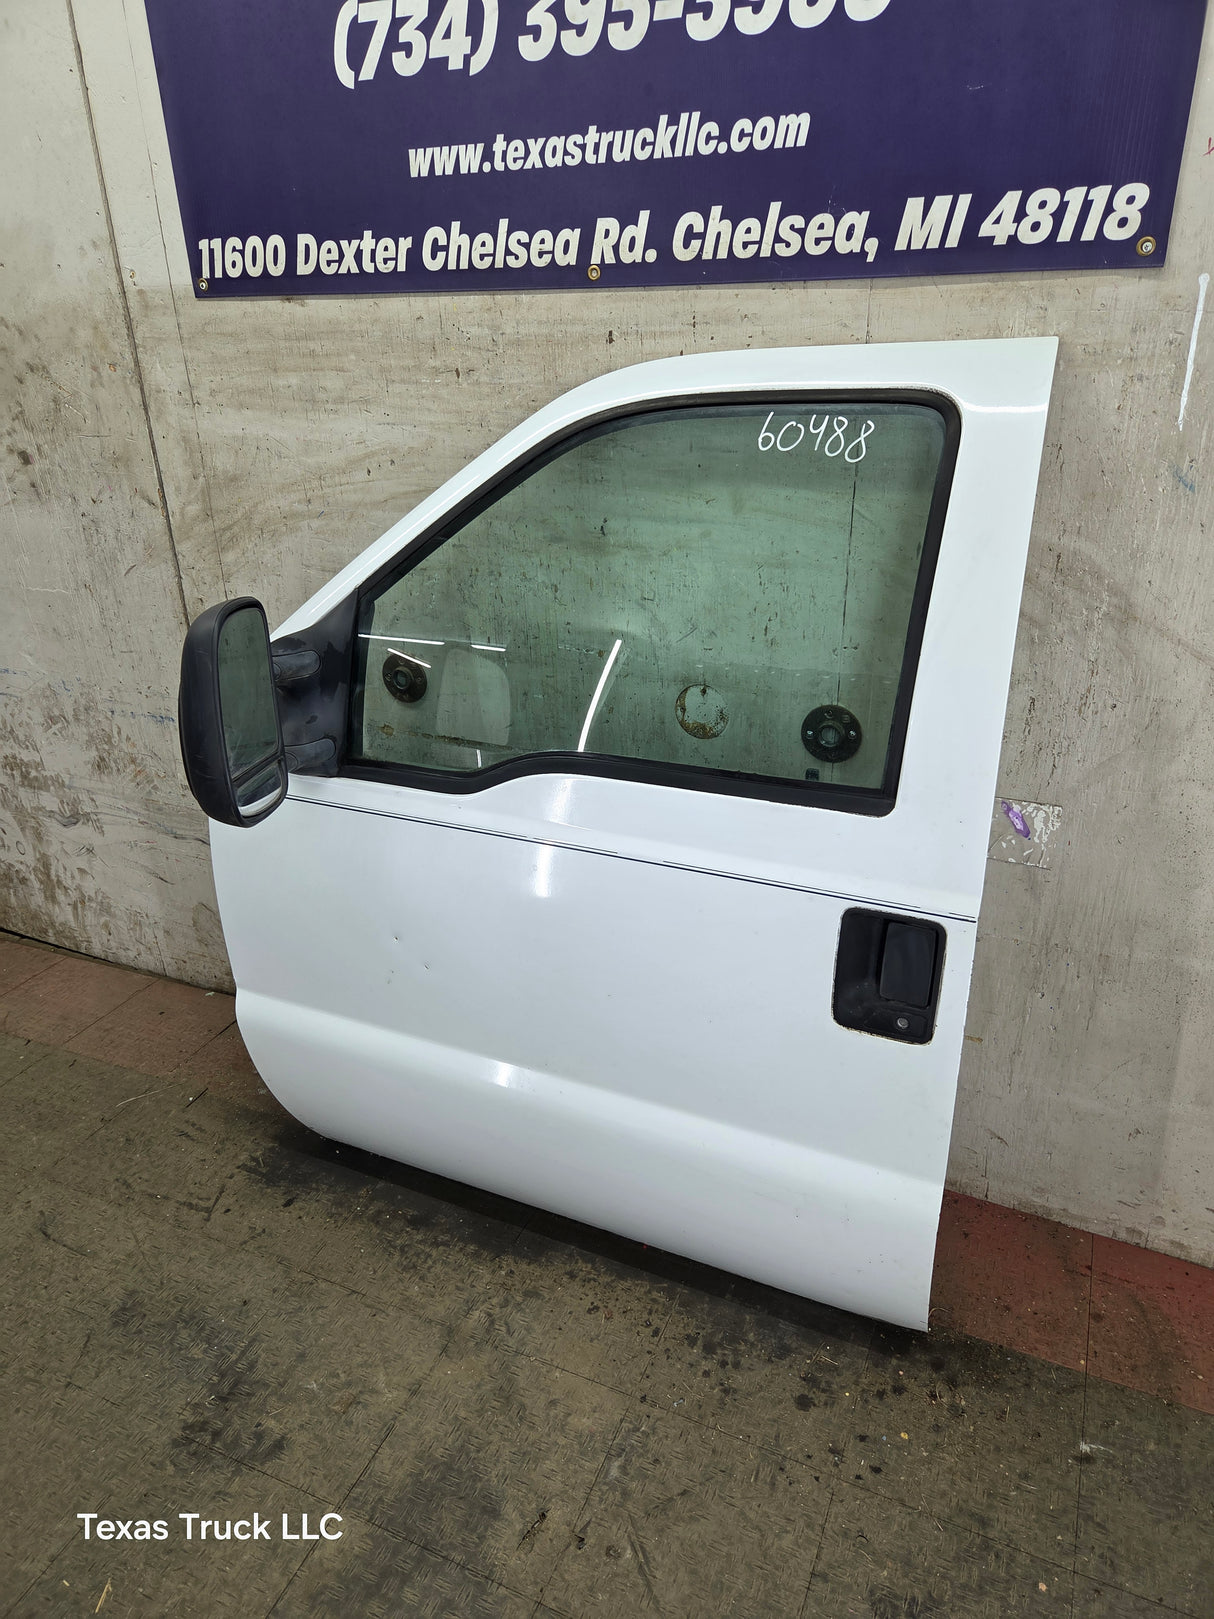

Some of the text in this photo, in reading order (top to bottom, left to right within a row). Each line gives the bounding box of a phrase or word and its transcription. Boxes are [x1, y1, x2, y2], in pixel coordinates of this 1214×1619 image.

[333, 0, 499, 90] (734)
[408, 112, 811, 178] www.texastruckllc.com
[198, 182, 1151, 279] 11600 Dexter Chelsea Rd. Chelsea, MI 48118
[757, 411, 875, 463] 60488
